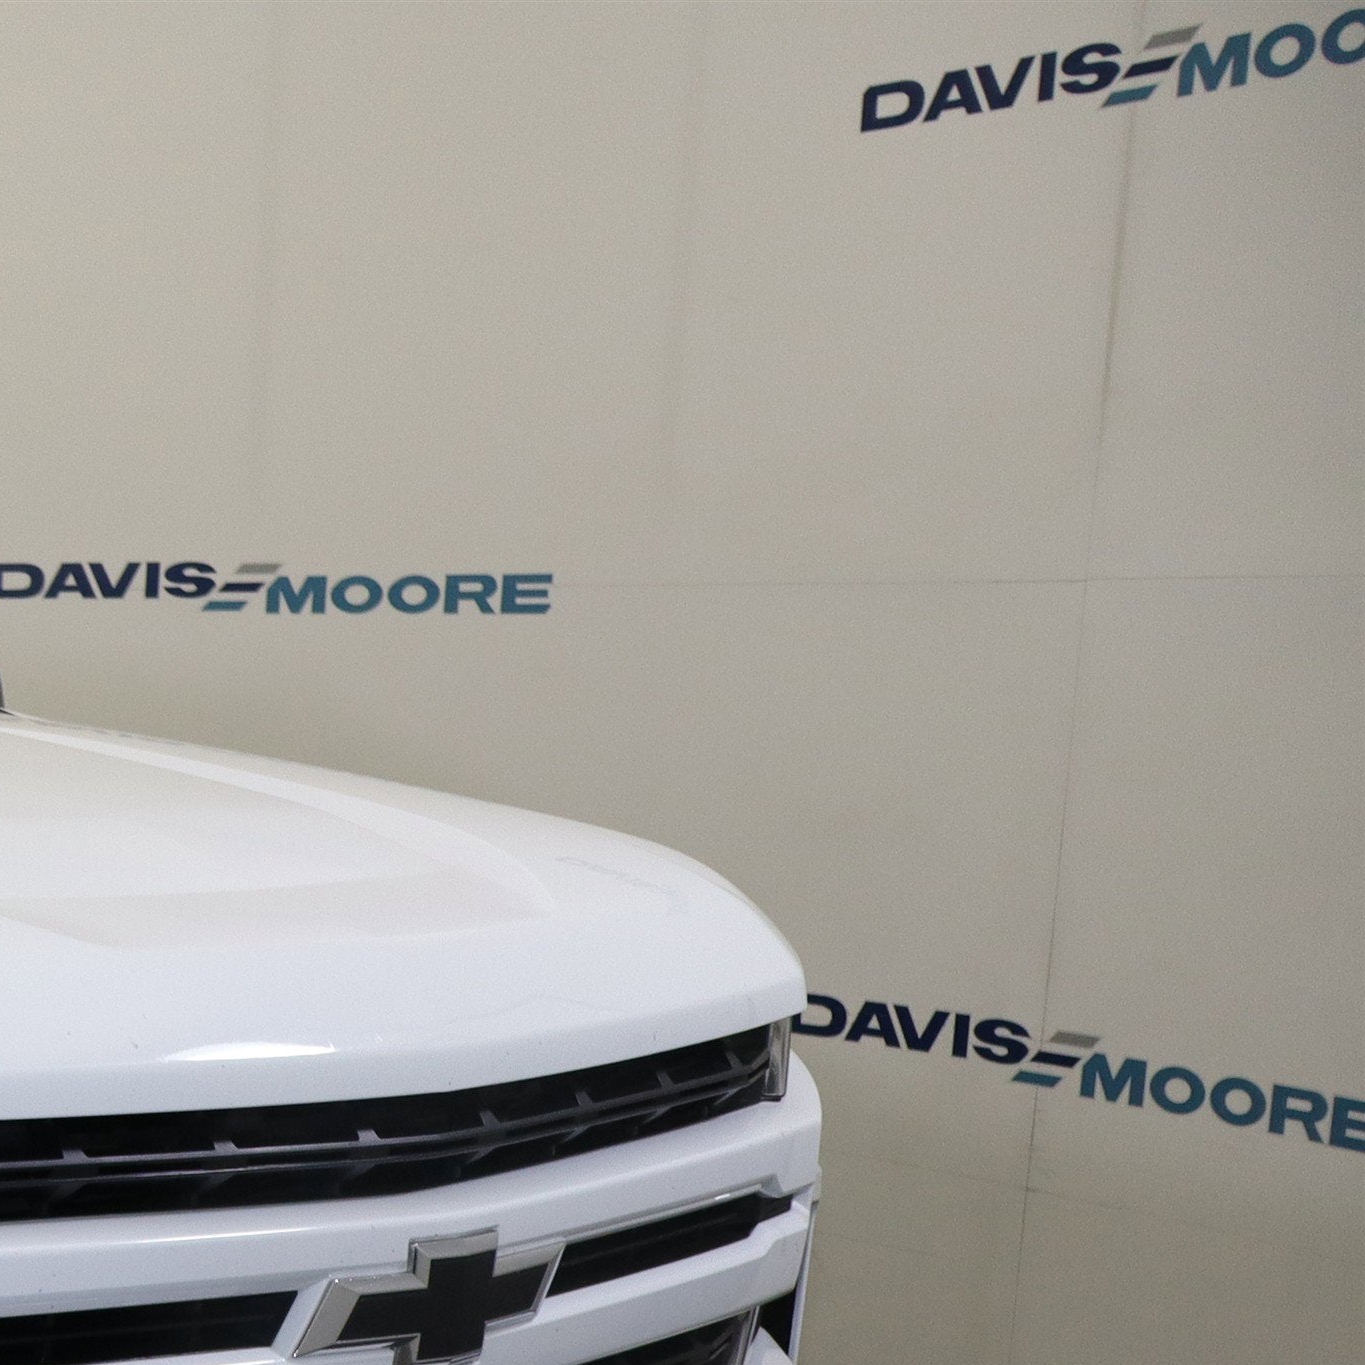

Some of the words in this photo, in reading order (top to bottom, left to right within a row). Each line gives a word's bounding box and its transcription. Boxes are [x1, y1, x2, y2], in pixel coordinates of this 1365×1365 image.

[860, 42, 1122, 132] DAVIS
[266, 574, 553, 614] MOORE
[789, 993, 1029, 1065] DAVIS
[1080, 1053, 1365, 1153] MOORE
